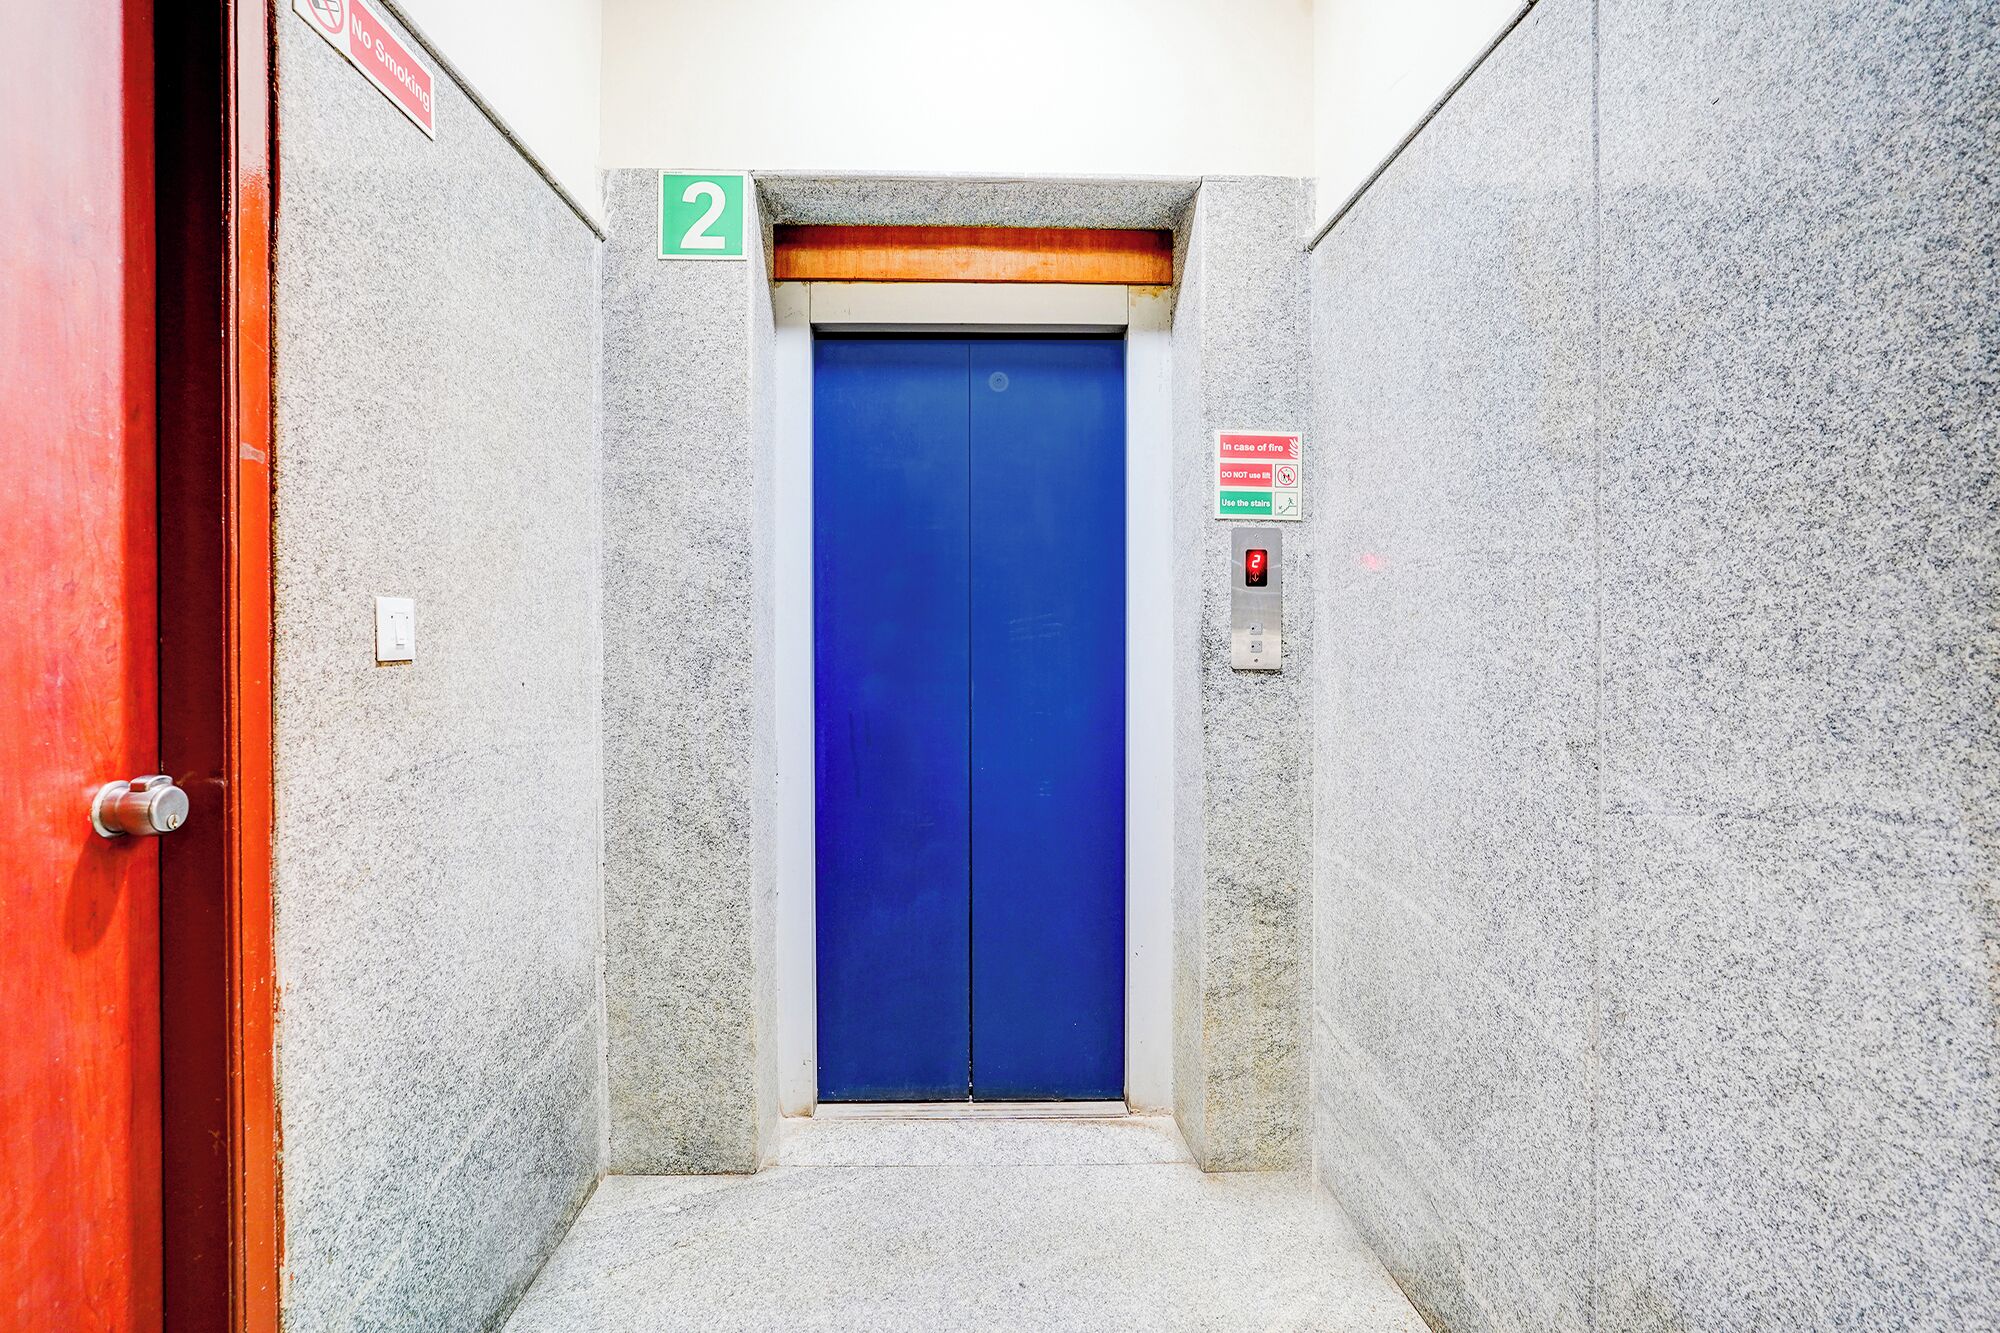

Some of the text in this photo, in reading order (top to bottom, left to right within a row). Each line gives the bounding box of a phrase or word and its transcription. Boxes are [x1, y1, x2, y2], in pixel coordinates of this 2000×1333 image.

[351, 13, 430, 112] No Smoking
[680, 181, 726, 250] 2
[1222, 442, 1284, 452] In case of fire
[1262, 471, 1271, 479] lift
[1221, 499, 1271, 507] Use the stairs
[1251, 554, 1261, 569] 2
